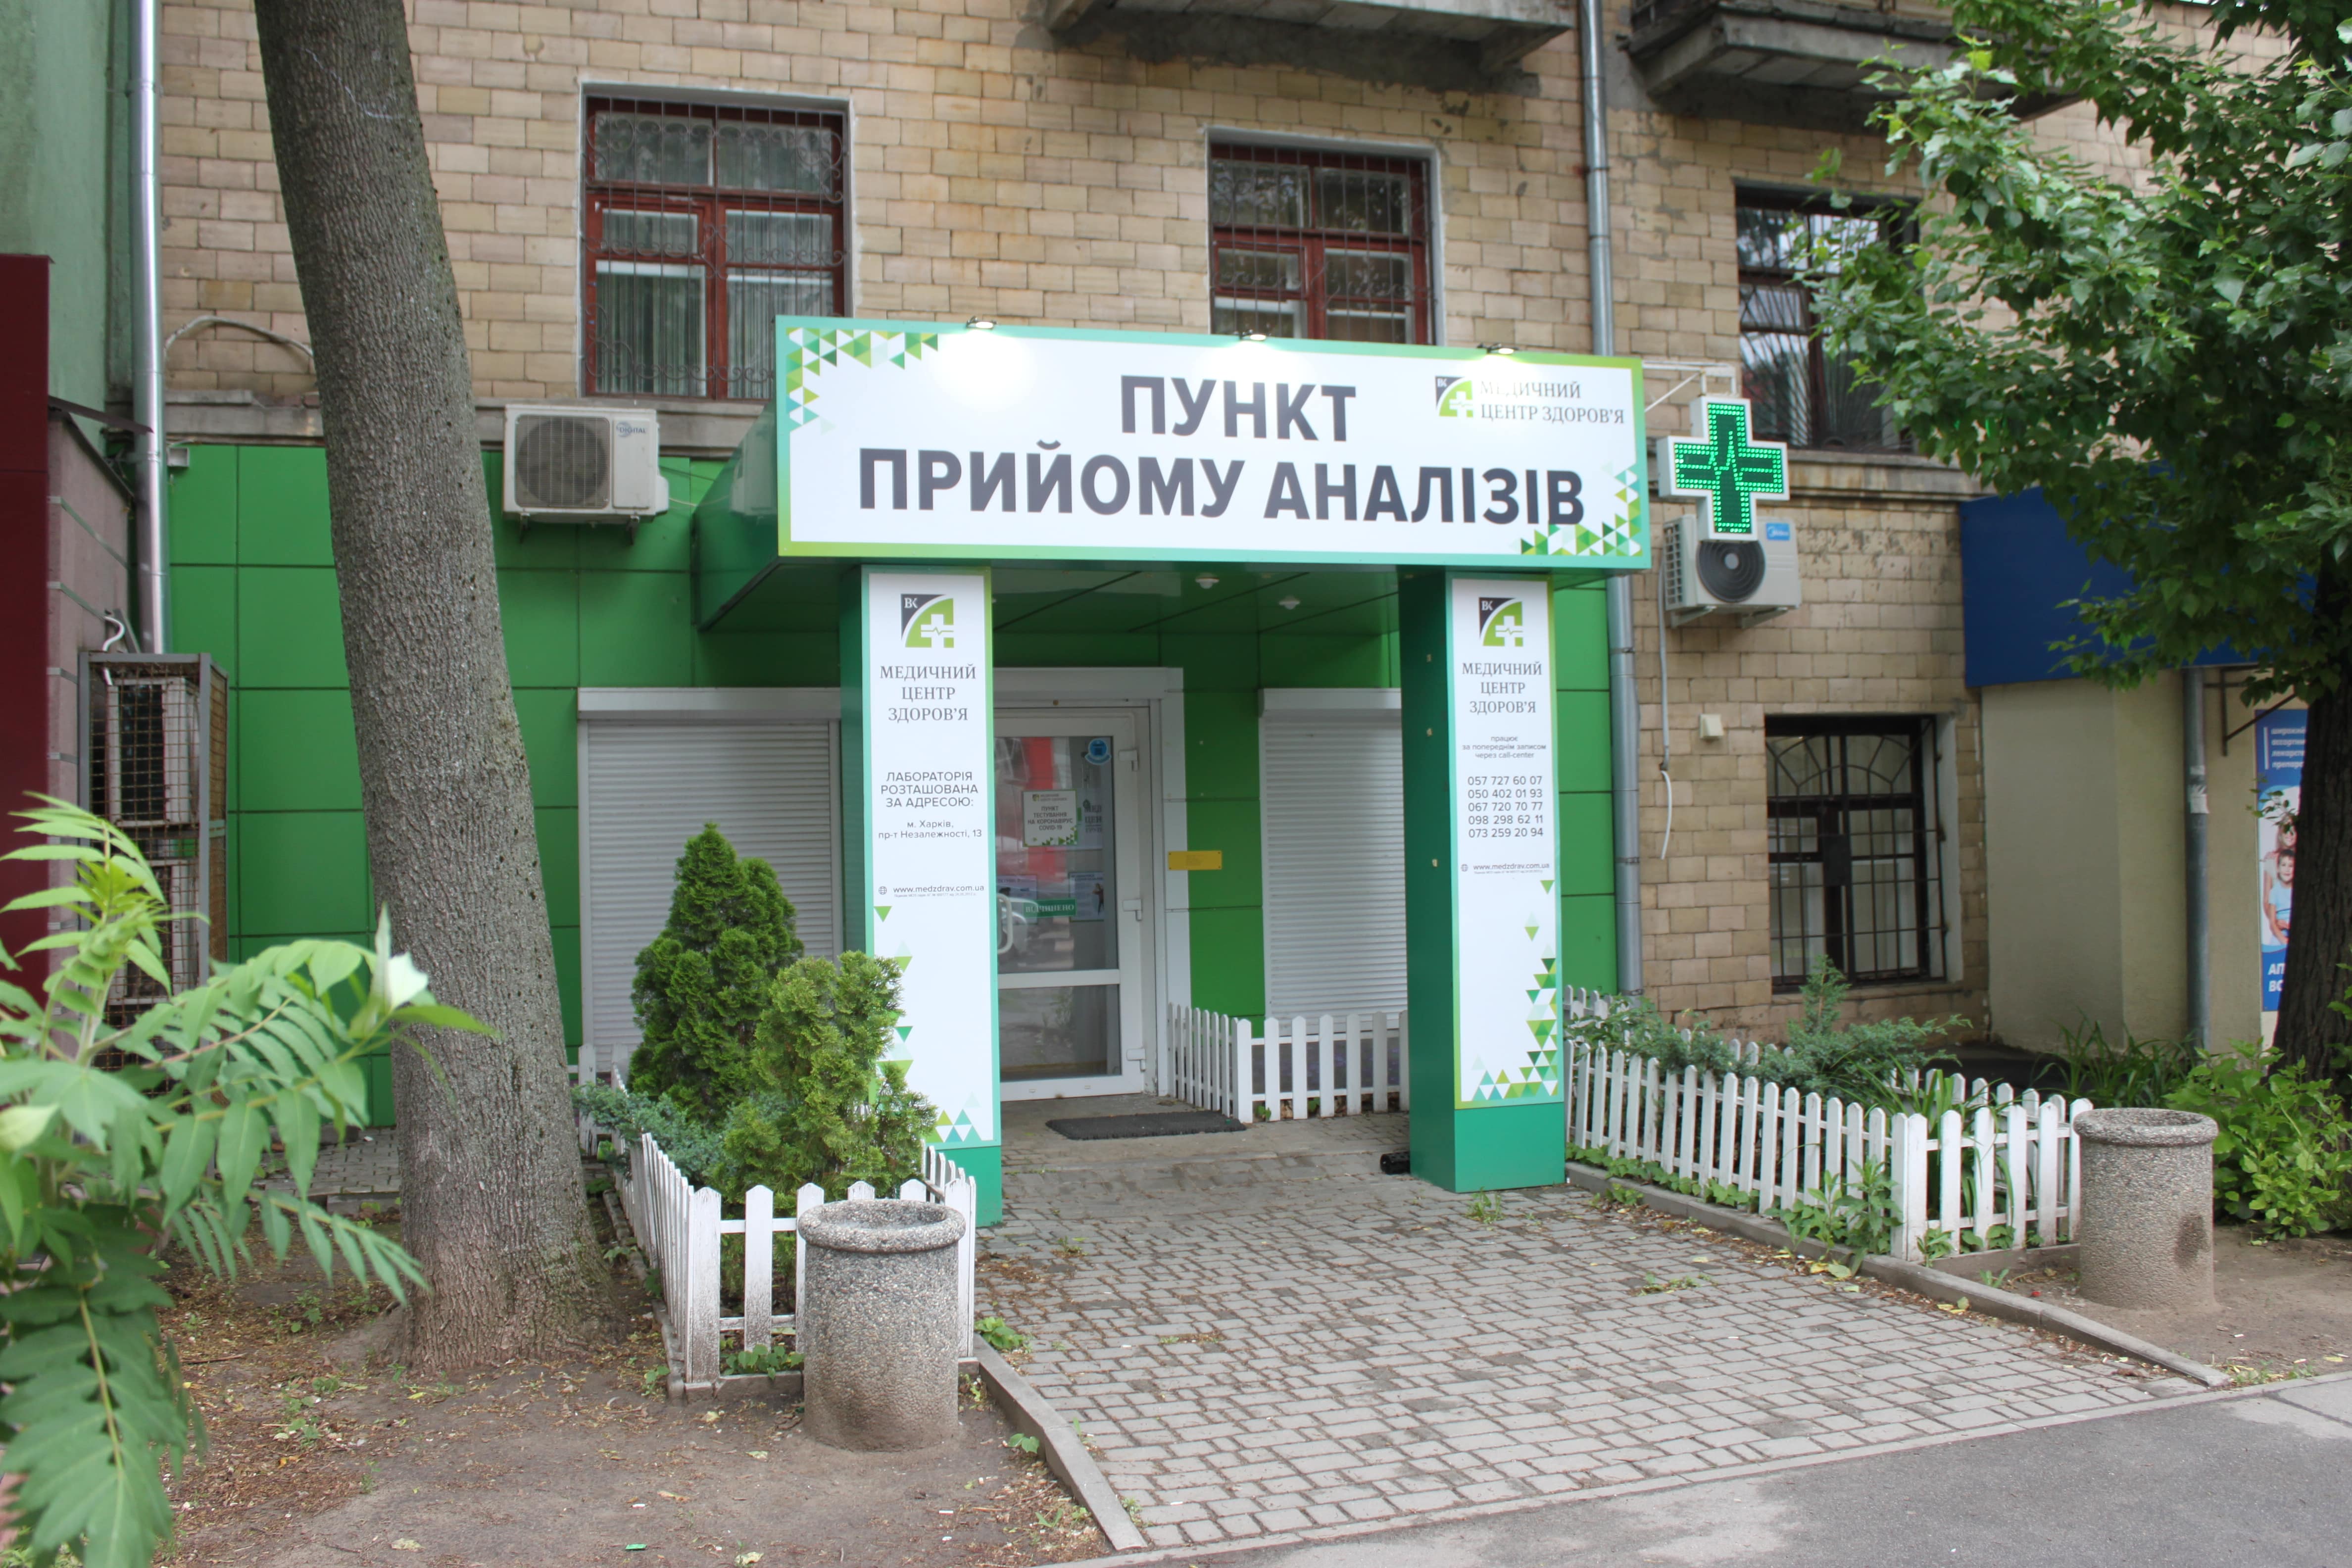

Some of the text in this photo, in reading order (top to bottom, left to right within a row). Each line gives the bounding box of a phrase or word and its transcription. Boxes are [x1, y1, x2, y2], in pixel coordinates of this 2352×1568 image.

[1481, 381, 1581, 398] МЕДИЧНИЙ
[1121, 375, 1356, 441] ПУНКТ
[1482, 404, 1623, 424] ЦЕНТР ЗДОРОВ'Я
[860, 439, 1584, 525] ПРИЙОМУ АНАЛІЗІВ
[880, 663, 976, 682] МЕДИЧНИЙ
[1462, 661, 1542, 677] МЕДИЧНИЙ
[902, 686, 956, 702] ЦЕНТР
[1480, 682, 1525, 696] ЦЕНТР
[1470, 701, 1536, 715] ЗДОРОВ'Я
[888, 708, 968, 723] ЗДОРОВ'Я
[886, 771, 972, 782] ЛАБОРАТОРІЯ
[1468, 776, 1543, 785] 057 727 60 07
[881, 784, 979, 795] РОЗТАШОВАНА
[1468, 788, 1543, 799] 050 402 01 93
[886, 797, 974, 809] ЗА АДРЕСОЮ:
[1468, 801, 1543, 812] 067 720 70 77
[919, 820, 954, 830] Харків,
[1468, 814, 1543, 825] 098 298 62 11
[878, 829, 982, 840] пр-т Незалежності, 13
[1468, 827, 1544, 838] 073 259 20 94
[1025, 904, 1076, 913] ВІДЧИНЕНО
